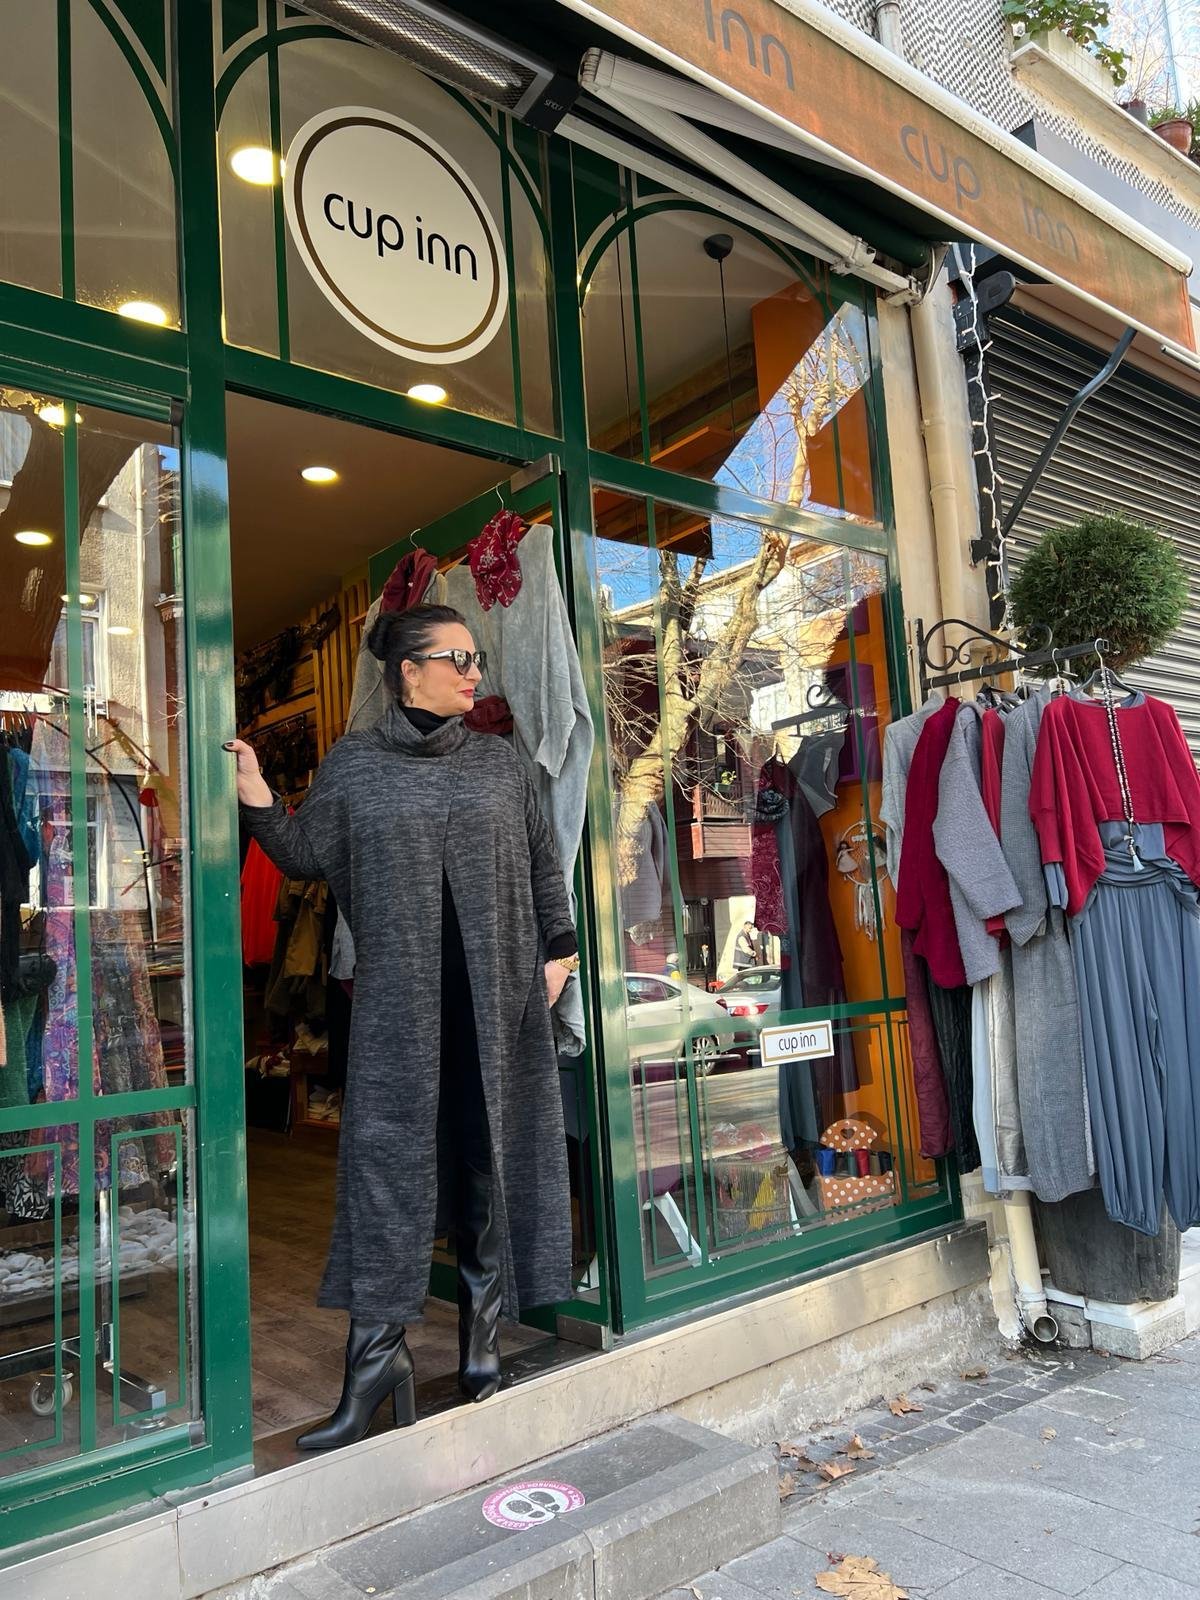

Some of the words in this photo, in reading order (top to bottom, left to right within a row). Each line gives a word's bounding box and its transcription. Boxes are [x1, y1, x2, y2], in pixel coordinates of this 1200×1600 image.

[323, 193, 404, 257] cup
[415, 215, 478, 281] inn
[900, 124, 982, 210] cup
[1019, 181, 1080, 263] inn
[778, 1036, 798, 1053] cup
[799, 1032, 817, 1048] inn
